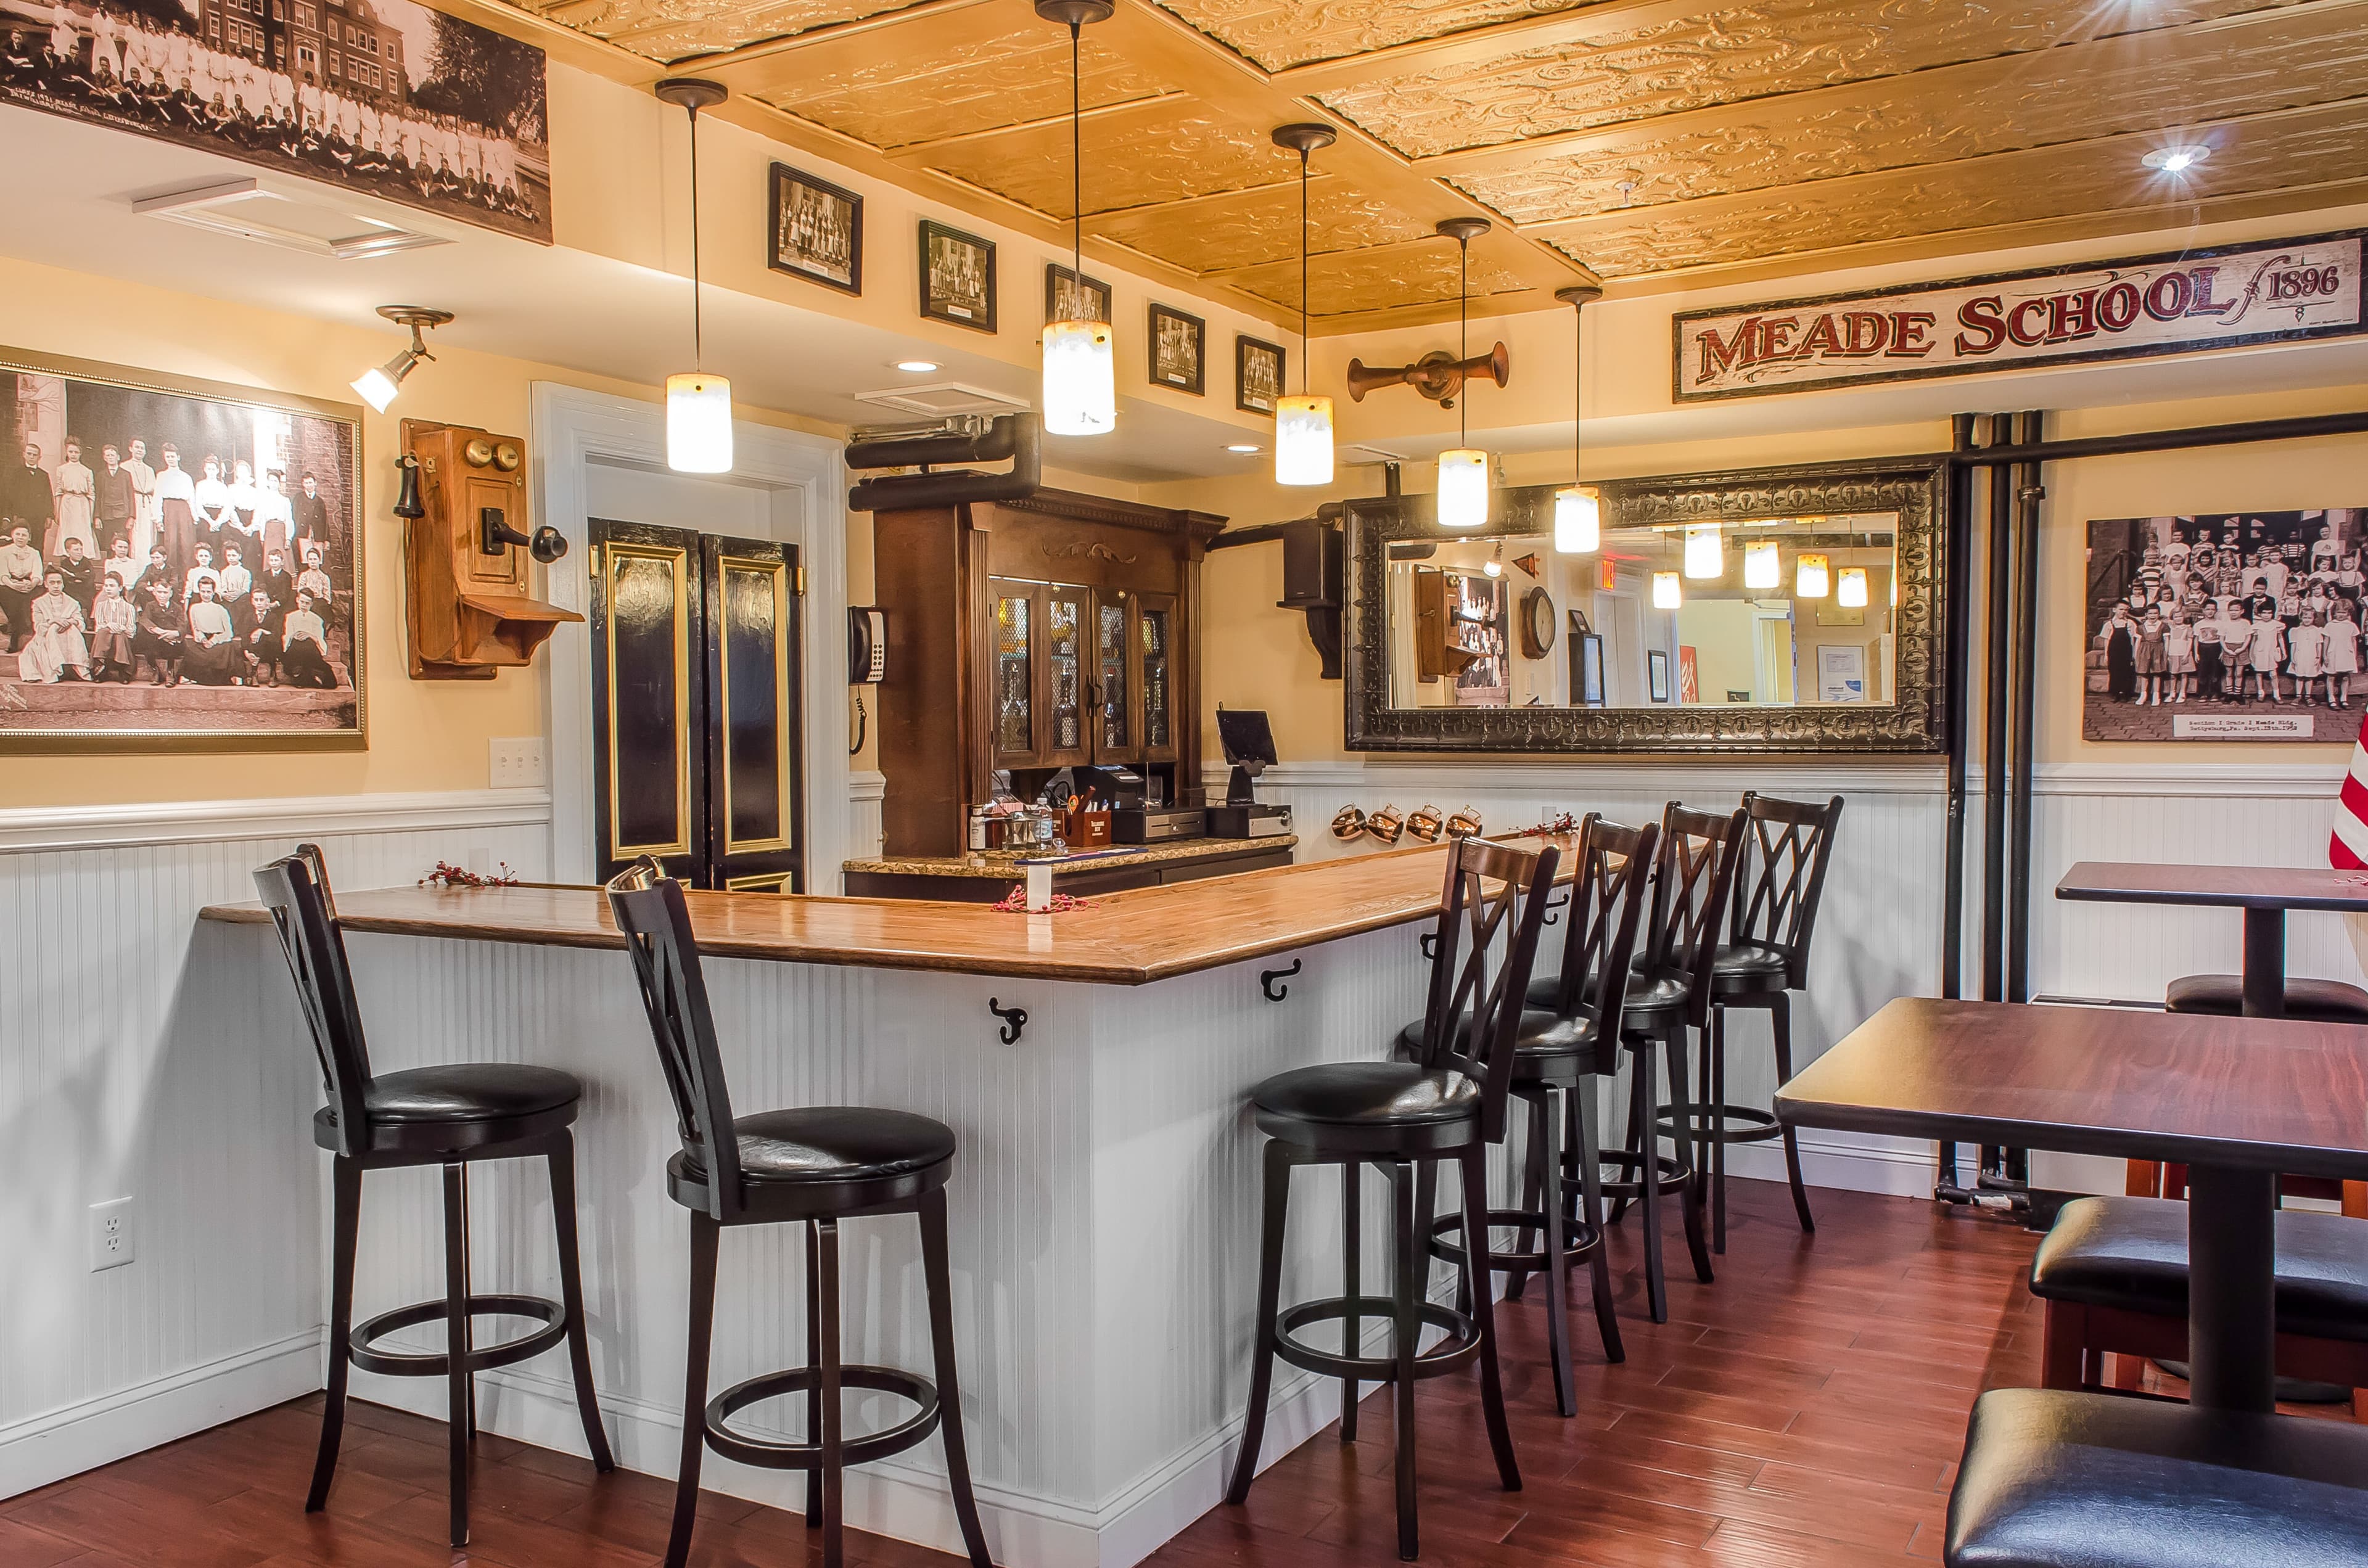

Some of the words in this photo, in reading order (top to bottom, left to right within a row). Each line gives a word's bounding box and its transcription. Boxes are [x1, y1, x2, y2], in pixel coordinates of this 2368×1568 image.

[2266, 266, 2340, 301] 1896
[1695, 312, 1937, 385] MEADE
[1954, 266, 2238, 357] SCHOOL
